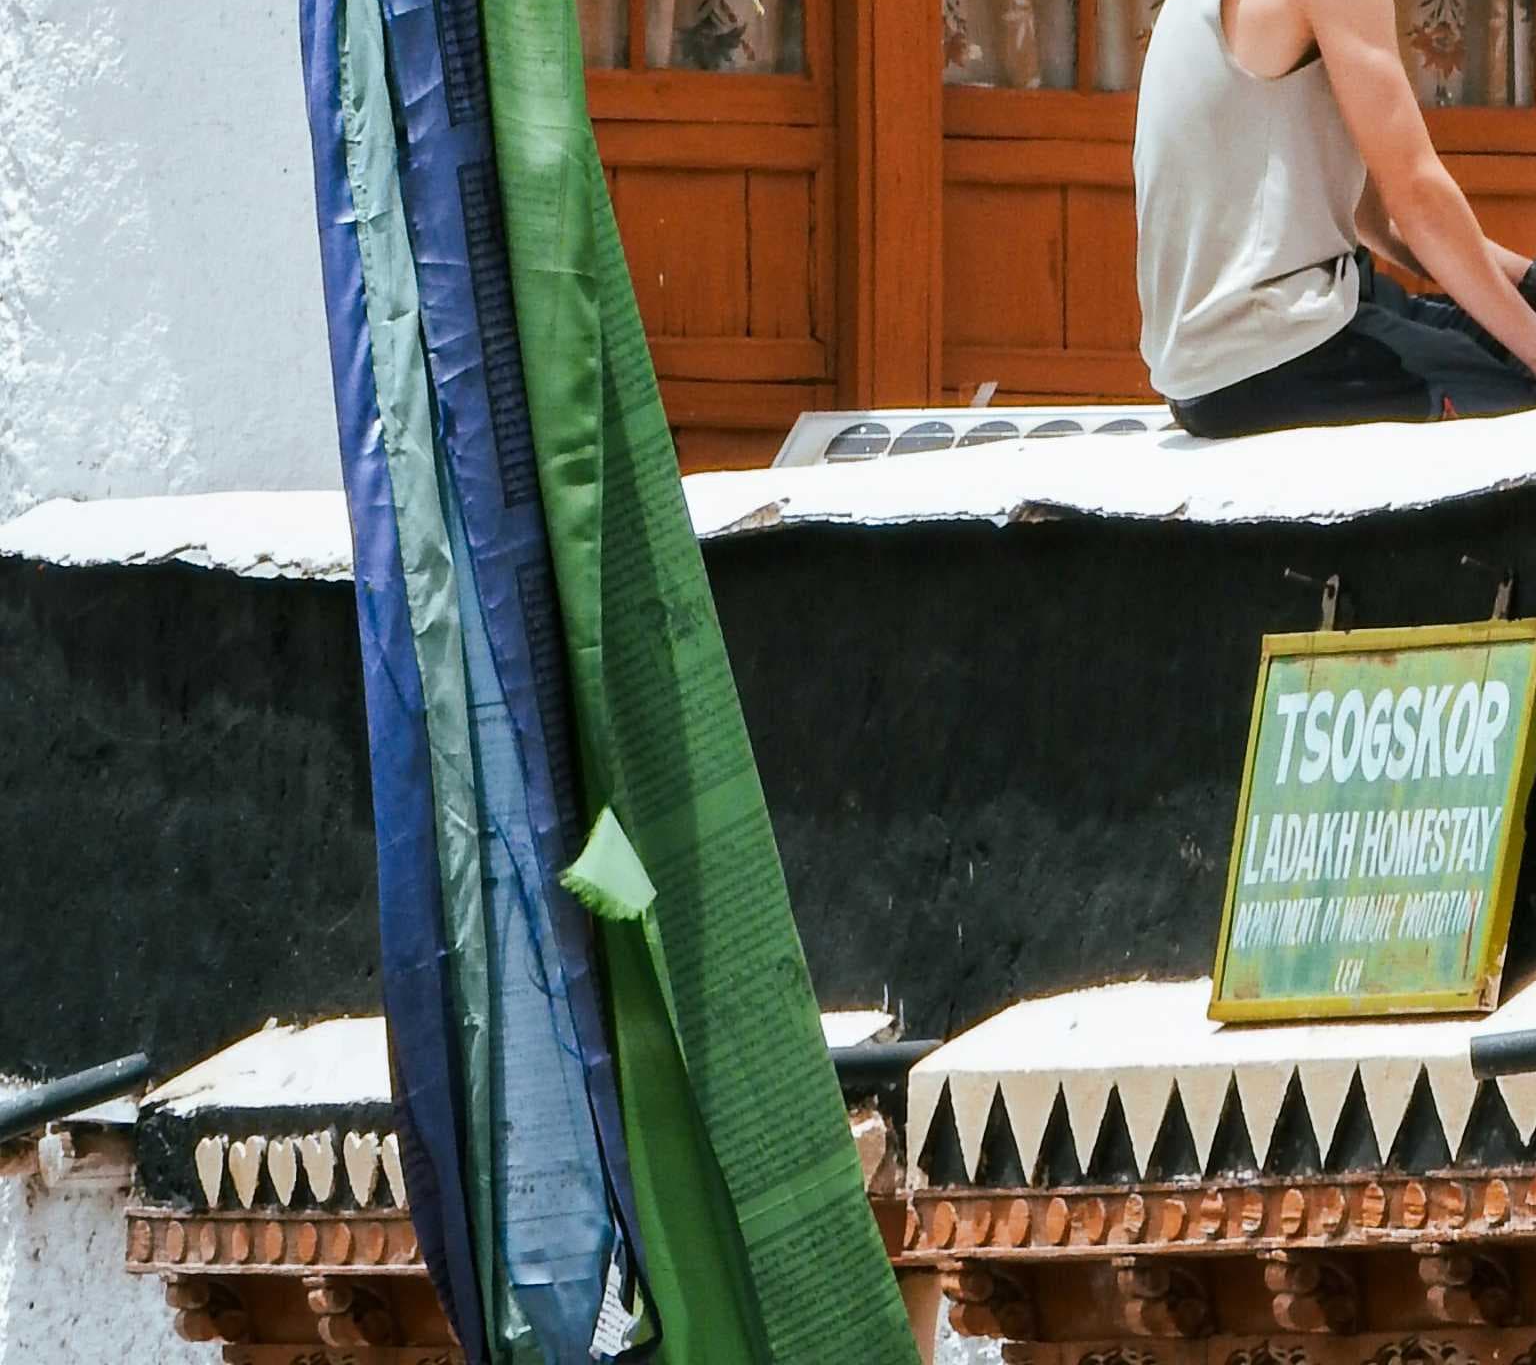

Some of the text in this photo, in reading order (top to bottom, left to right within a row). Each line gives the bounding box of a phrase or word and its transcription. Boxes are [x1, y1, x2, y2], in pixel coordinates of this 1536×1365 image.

[1275, 680, 1510, 785] TSOGSKOR
[1243, 806, 1503, 885] LADAKH HOMESTAY
[1231, 889, 1484, 950] DEPARTMENT OF WILDLIFE PROTECTION
[1334, 957, 1364, 994] LEH
